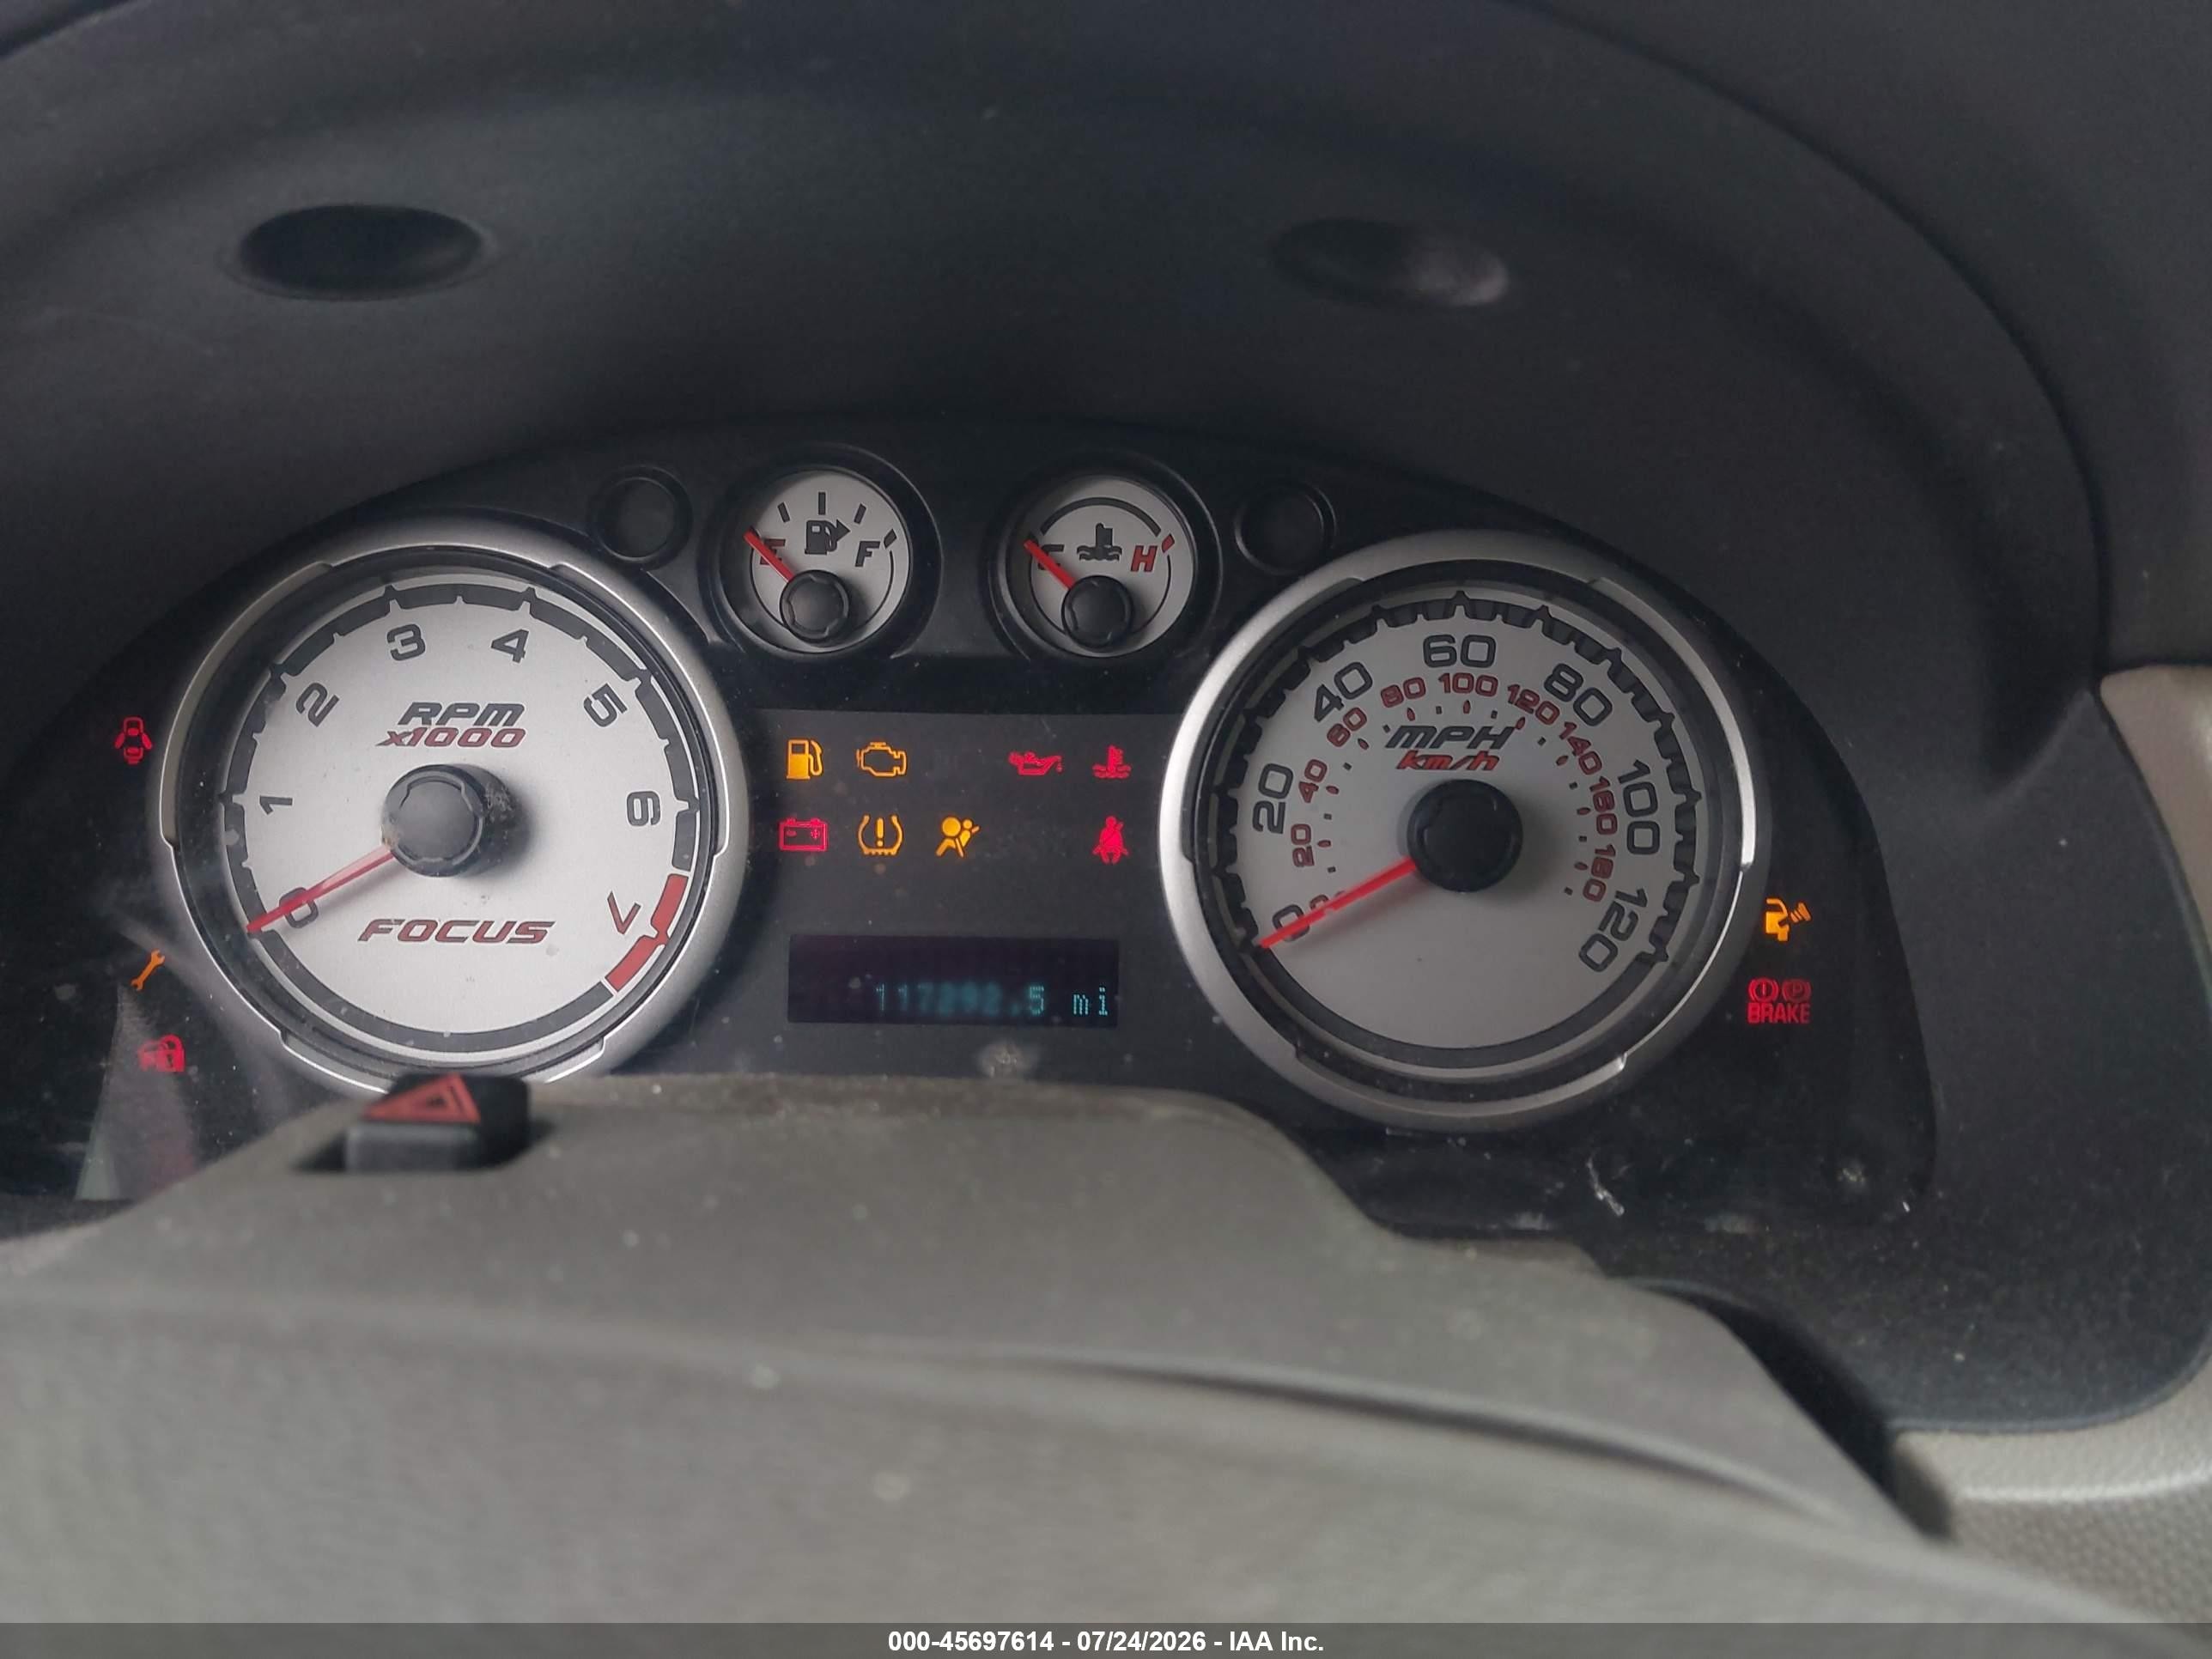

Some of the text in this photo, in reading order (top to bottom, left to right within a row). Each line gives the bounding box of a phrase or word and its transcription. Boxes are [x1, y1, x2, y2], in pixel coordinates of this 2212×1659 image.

[855, 541, 880, 567] F
[1131, 546, 1156, 572] H
[386, 623, 426, 662] 3
[491, 629, 529, 663] 4
[1422, 635, 1495, 667] 60
[1312, 660, 1372, 722] 40
[1381, 677, 1425, 708] 80
[1439, 672, 1498, 697] 100
[1544, 662, 1612, 726] 80
[295, 683, 339, 726] 2
[398, 702, 525, 726] RPM
[583, 683, 629, 727] 5
[1507, 684, 1559, 725] 120
[376, 727, 526, 747] x1000
[1327, 707, 1367, 747] 60
[1386, 725, 1515, 750] MPH
[1396, 749, 1499, 771] km/h
[1560, 721, 1601, 775] 140
[1252, 764, 1294, 835] 20
[1298, 758, 1327, 803] 40
[258, 794, 293, 815] 1
[626, 791, 660, 827] 6
[1590, 775, 1617, 836] 160
[1618, 759, 1660, 855] 100
[1291, 823, 1315, 867] 20
[1583, 844, 1615, 902] 180
[278, 888, 318, 928] 0
[608, 891, 641, 934] 7
[1272, 904, 1310, 941] 0
[358, 920, 555, 944] FOCUS
[1578, 887, 1648, 972] 120
[1073, 987, 1108, 1016] mi
[1747, 1003, 1810, 1024] BRAKE
